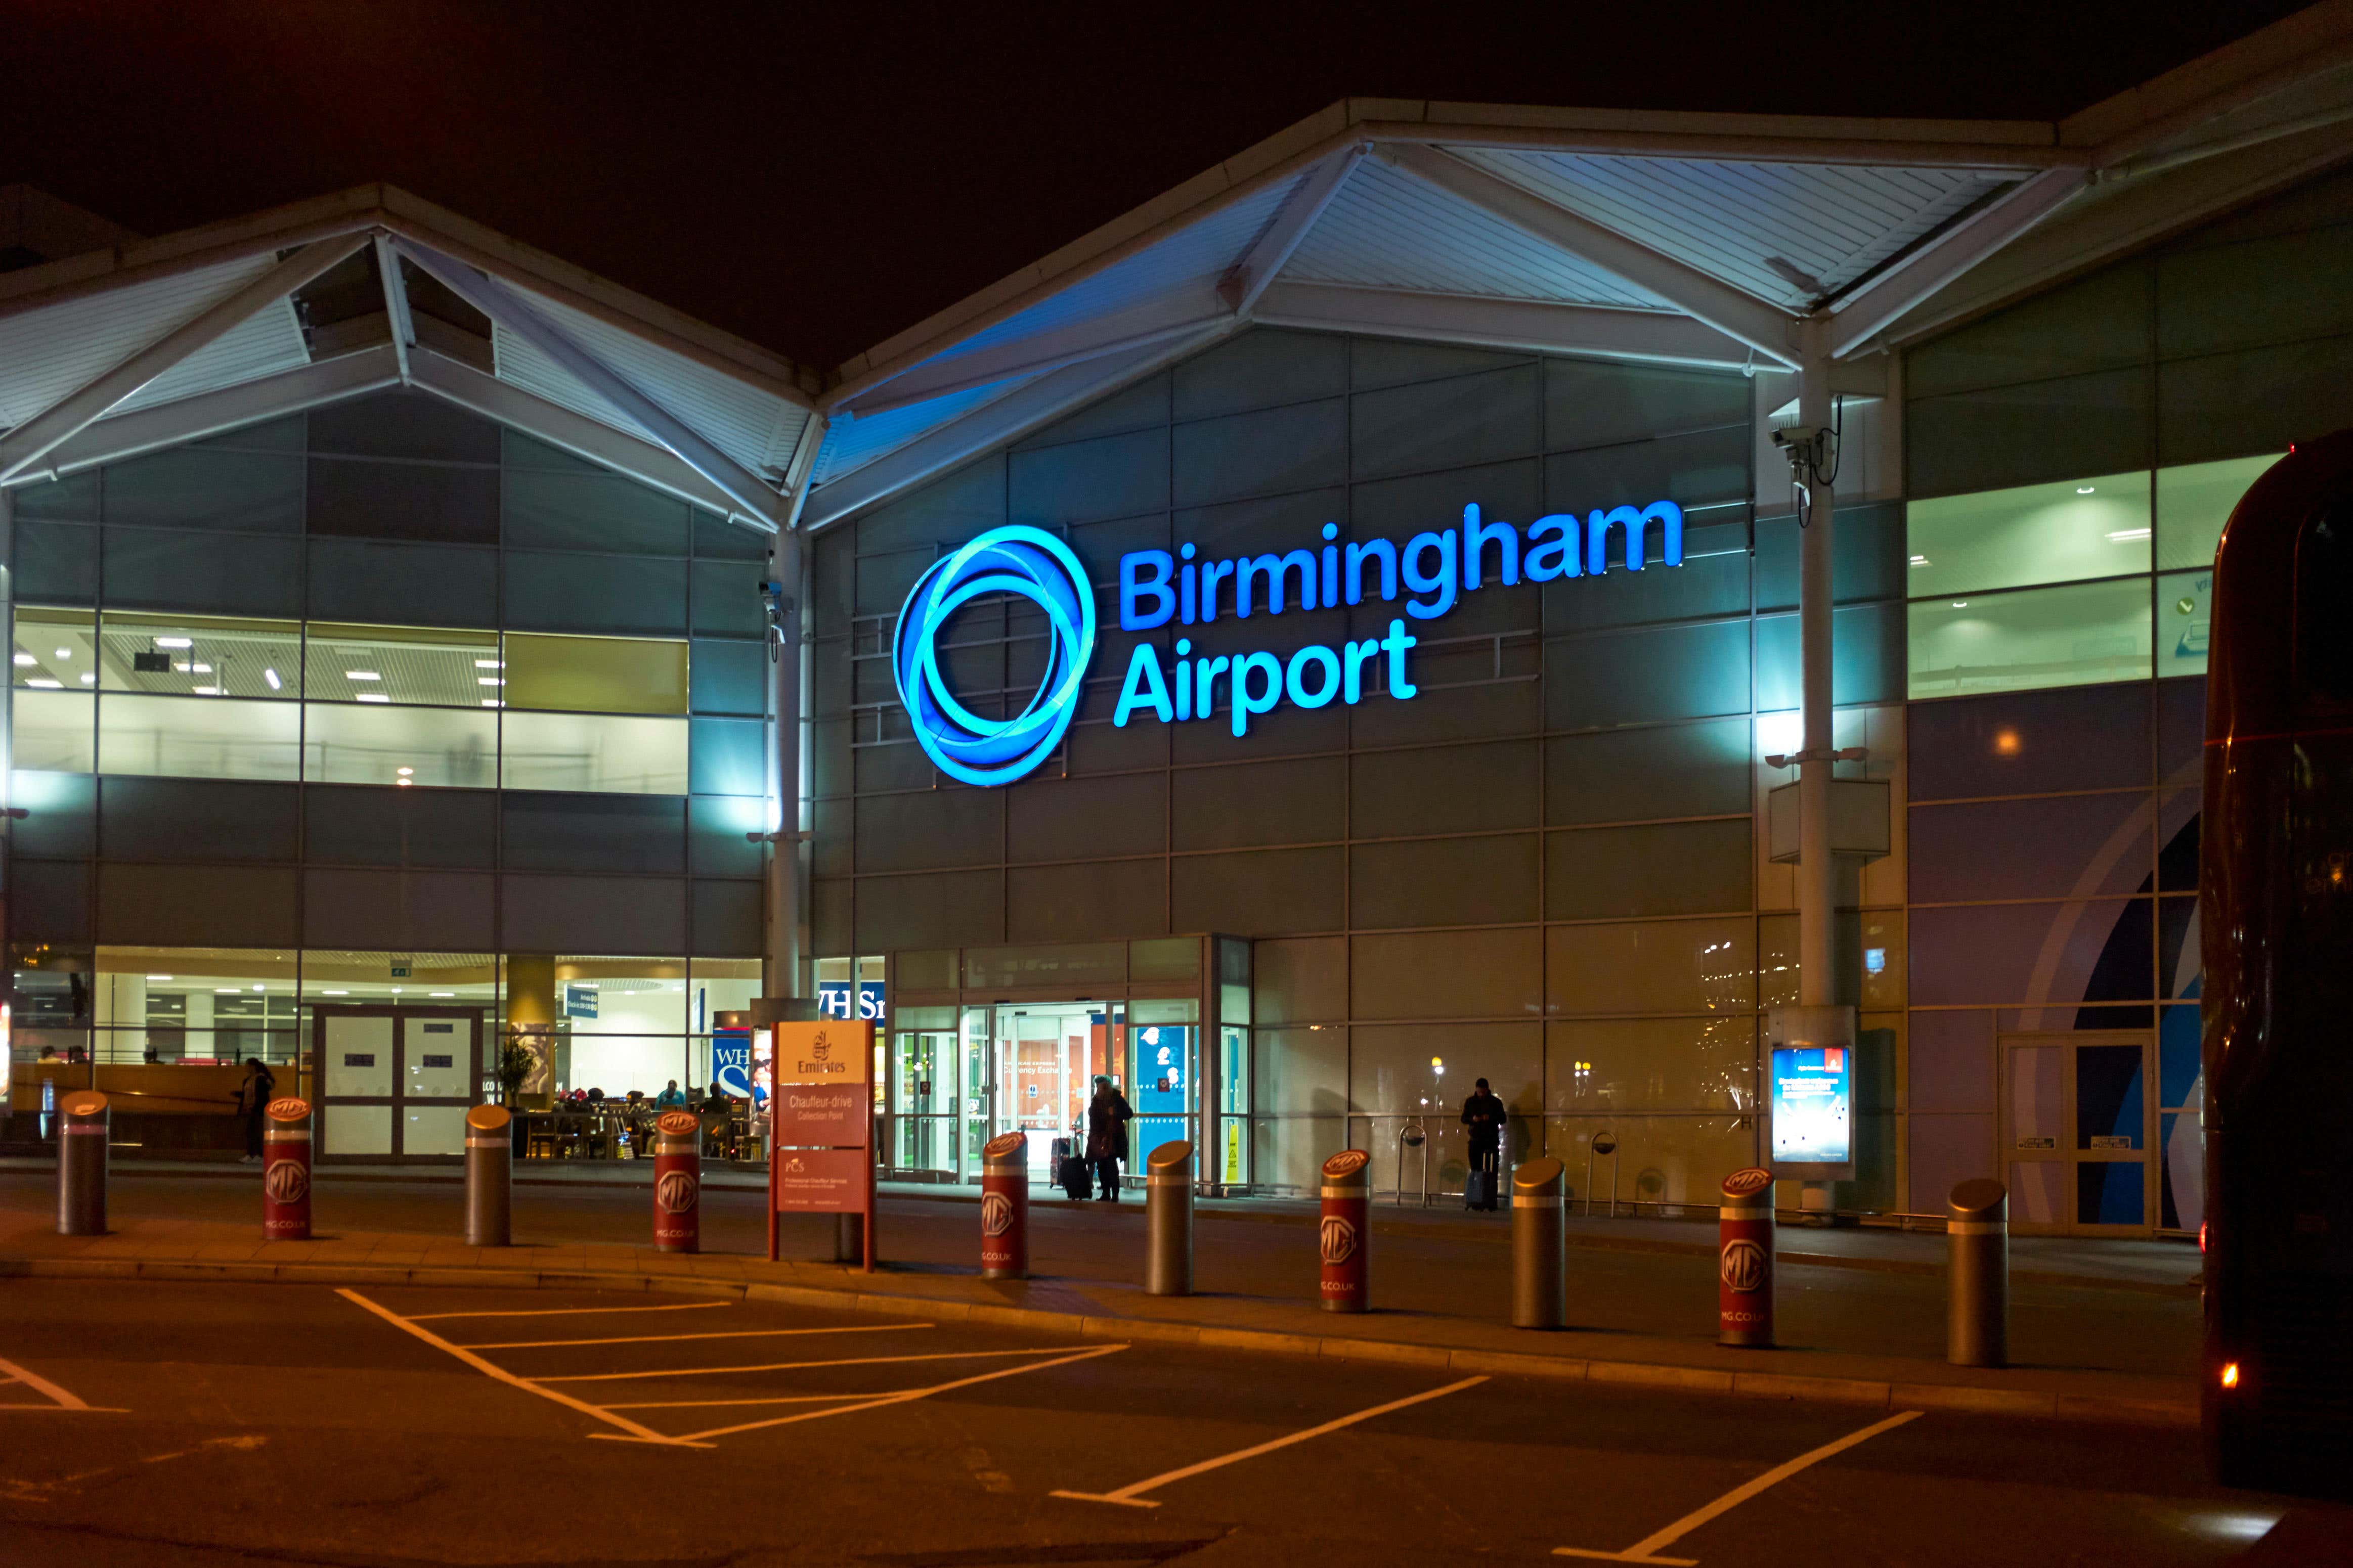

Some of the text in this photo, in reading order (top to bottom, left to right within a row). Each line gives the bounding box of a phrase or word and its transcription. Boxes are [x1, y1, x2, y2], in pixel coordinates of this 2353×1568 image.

[1120, 500, 1684, 632] Birmingham
[1113, 618, 1417, 737] Airport
[716, 1049, 750, 1064] WH
[798, 1060, 846, 1073] Emirates
[1004, 1067, 1036, 1075] Cuency
[789, 1095, 852, 1108] Chauffeur-drive
[785, 1162, 805, 1173] PCS
[1724, 1243, 1765, 1289] MG
